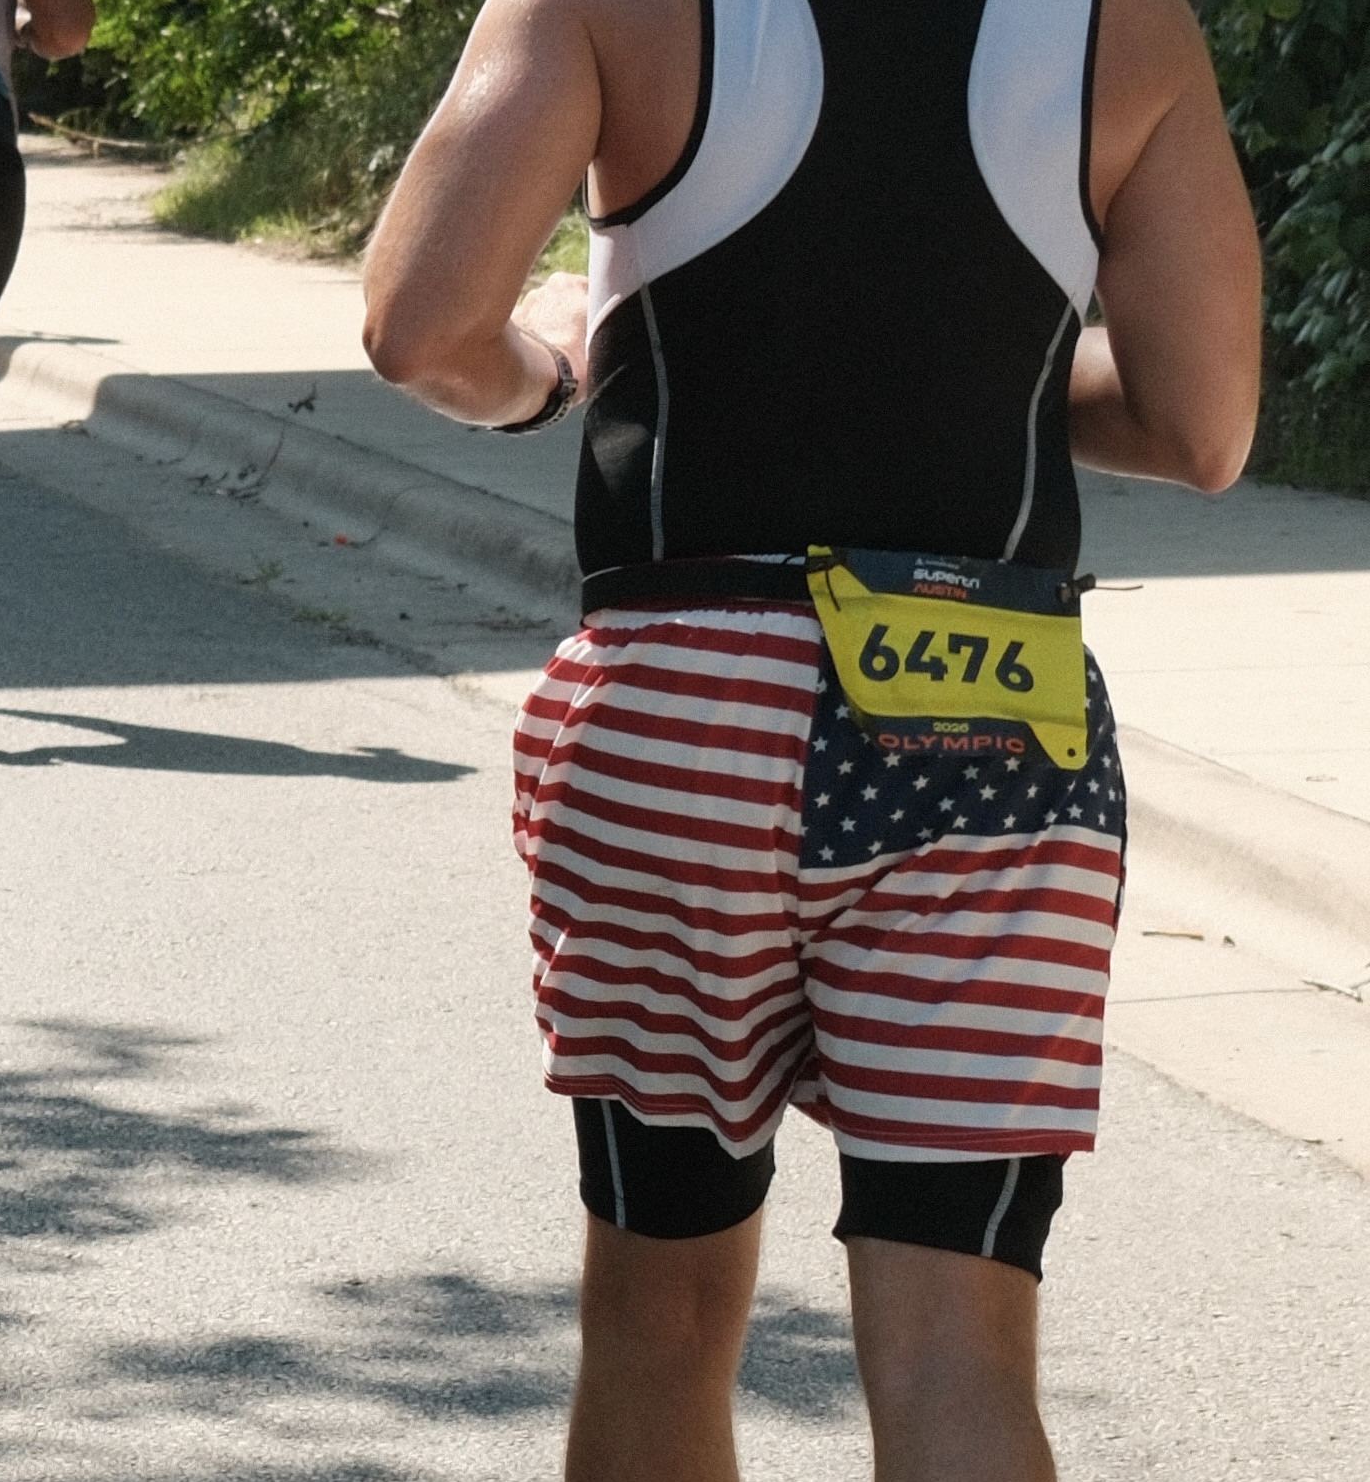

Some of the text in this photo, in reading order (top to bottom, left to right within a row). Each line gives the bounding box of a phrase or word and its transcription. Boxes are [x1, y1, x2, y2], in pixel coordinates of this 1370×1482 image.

[913, 568, 980, 589] supertri
[859, 623, 1034, 693] 6476
[933, 721, 969, 733] 2026
[878, 733, 1026, 754] OLYMPIC
